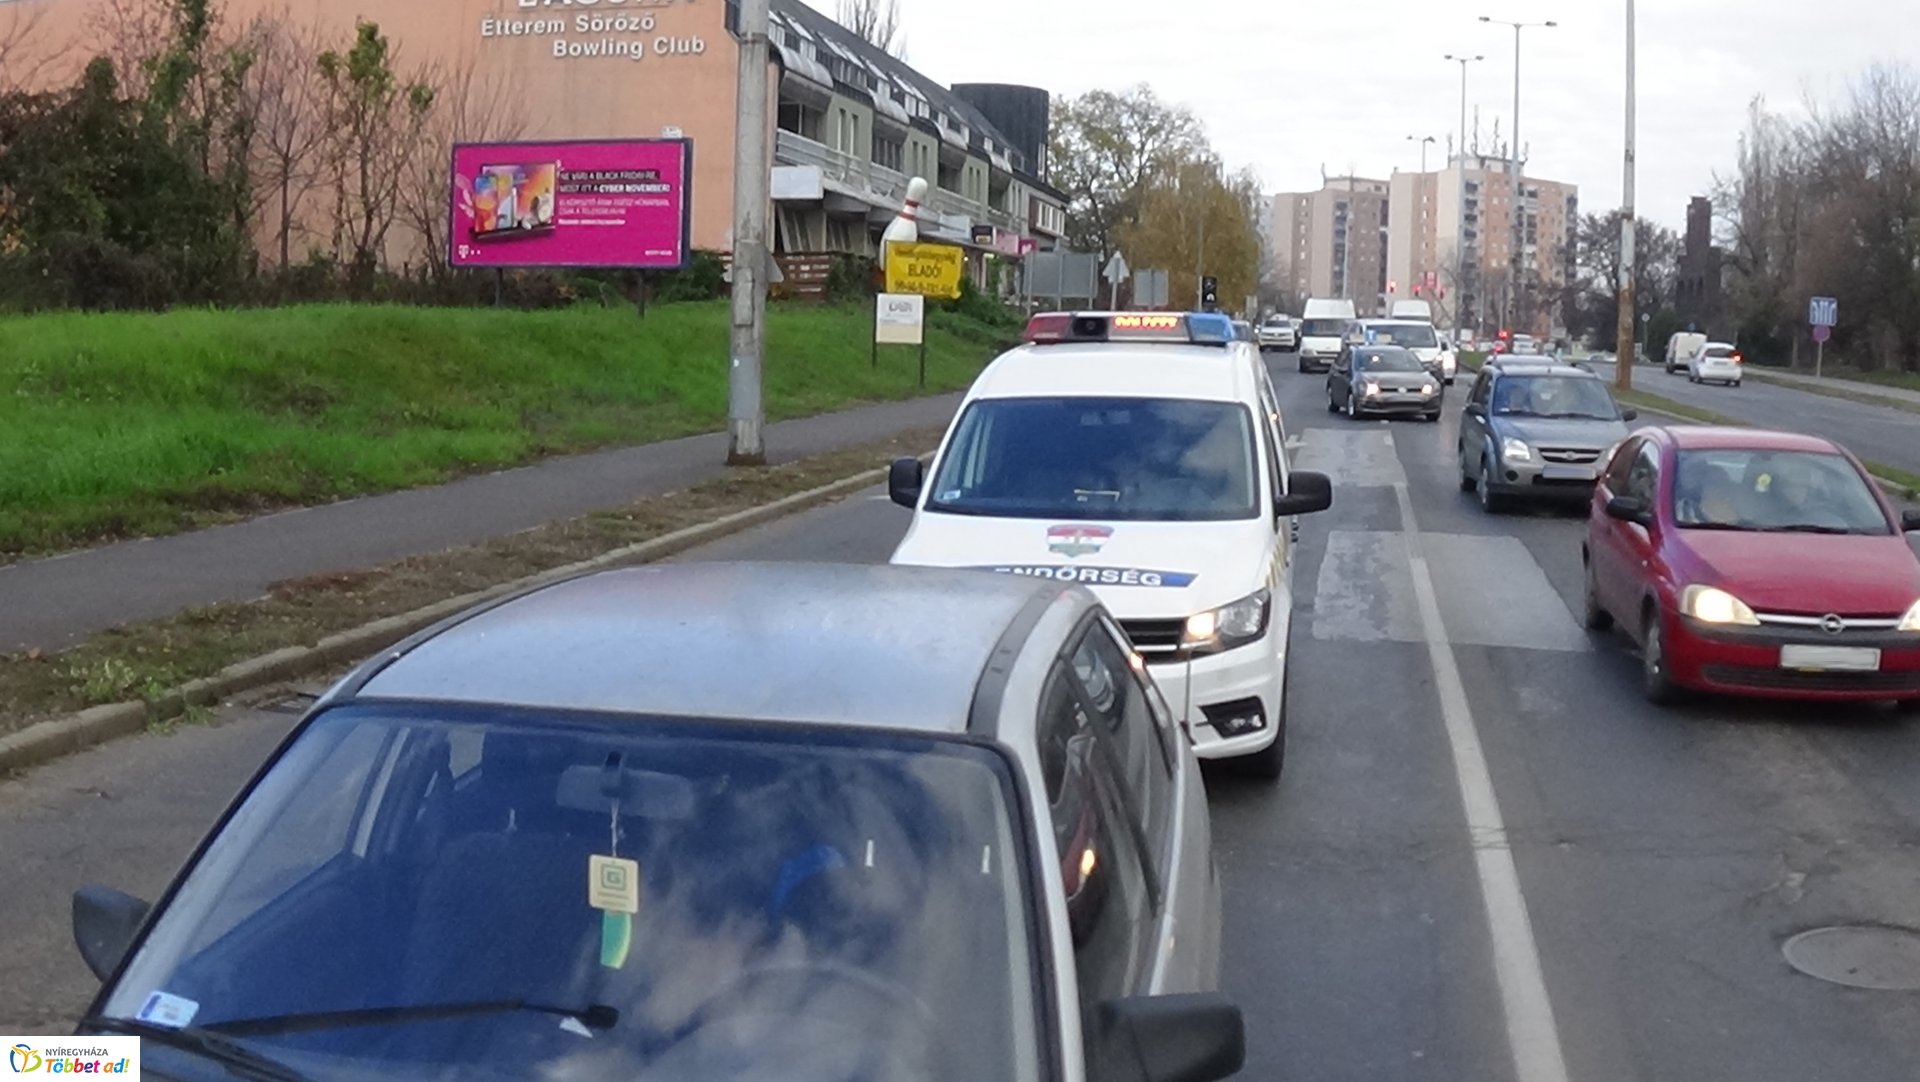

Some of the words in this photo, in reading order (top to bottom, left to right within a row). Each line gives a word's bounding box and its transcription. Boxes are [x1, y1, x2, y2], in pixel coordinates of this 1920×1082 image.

[480, 15, 565, 36] Étterem
[553, 38, 644, 58] Bowling
[653, 36, 705, 54] Club
[599, 184, 624, 193] CYBER
[995, 564, 1161, 586] NDŐRSÉG
